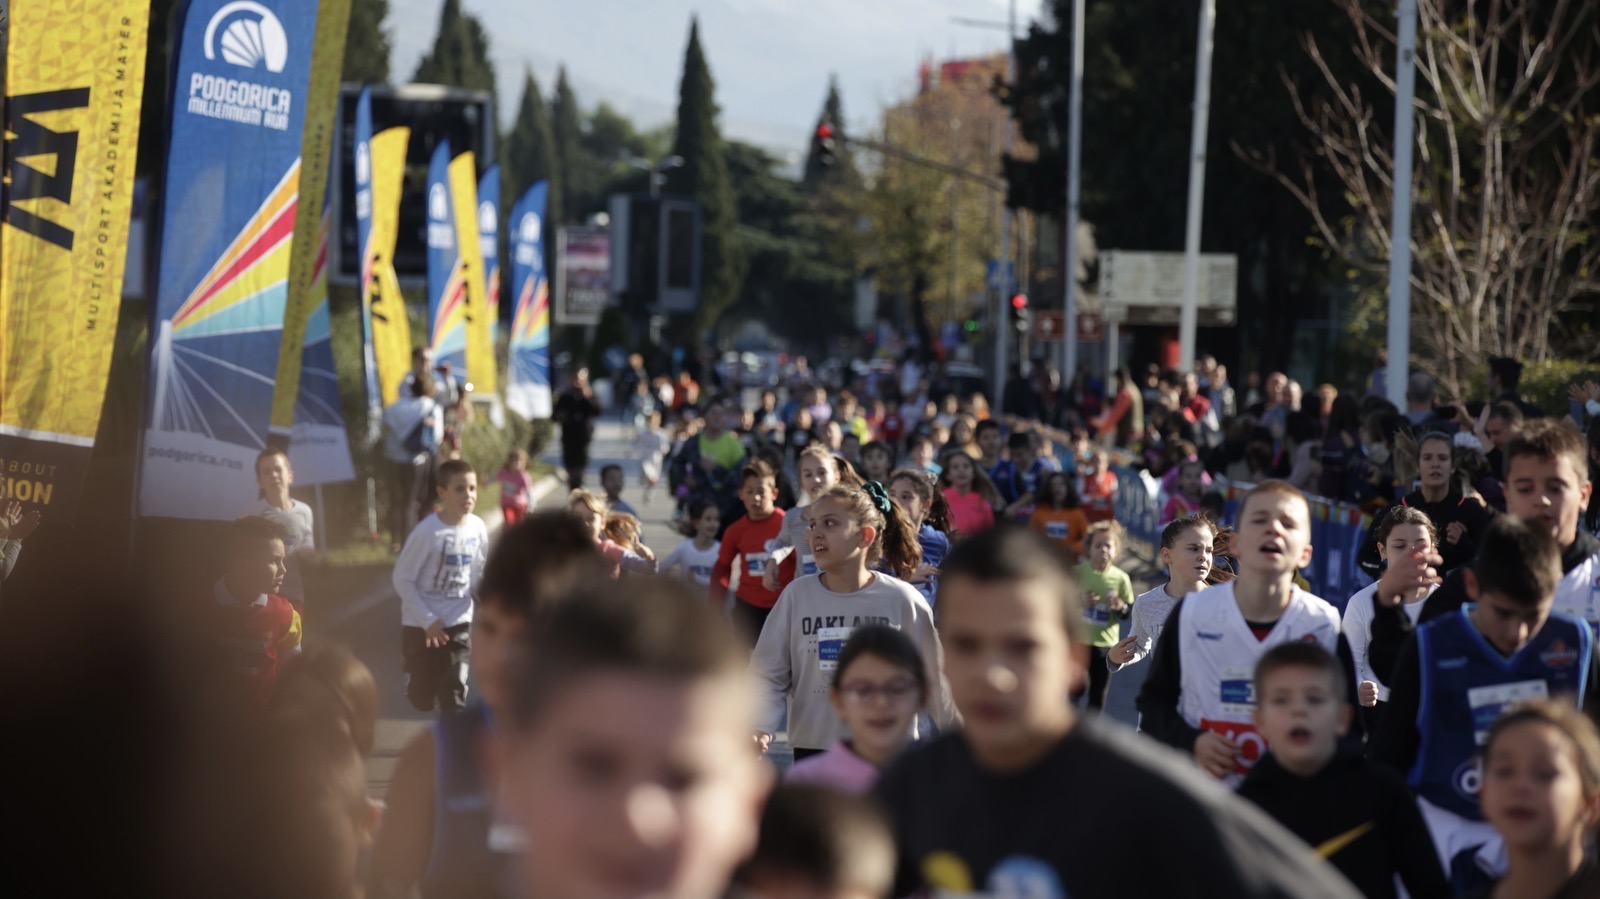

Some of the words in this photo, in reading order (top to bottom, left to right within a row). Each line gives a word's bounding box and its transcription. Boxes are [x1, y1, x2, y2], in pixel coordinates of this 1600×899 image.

[190, 72, 291, 114] PODGORICA
[264, 111, 289, 131] RUN
[86, 207, 111, 331] MULTISPORT
[103, 89, 123, 201] AKADEMIJA
[115, 16, 131, 81] MAYER
[147, 446, 244, 470] podgorica.run
